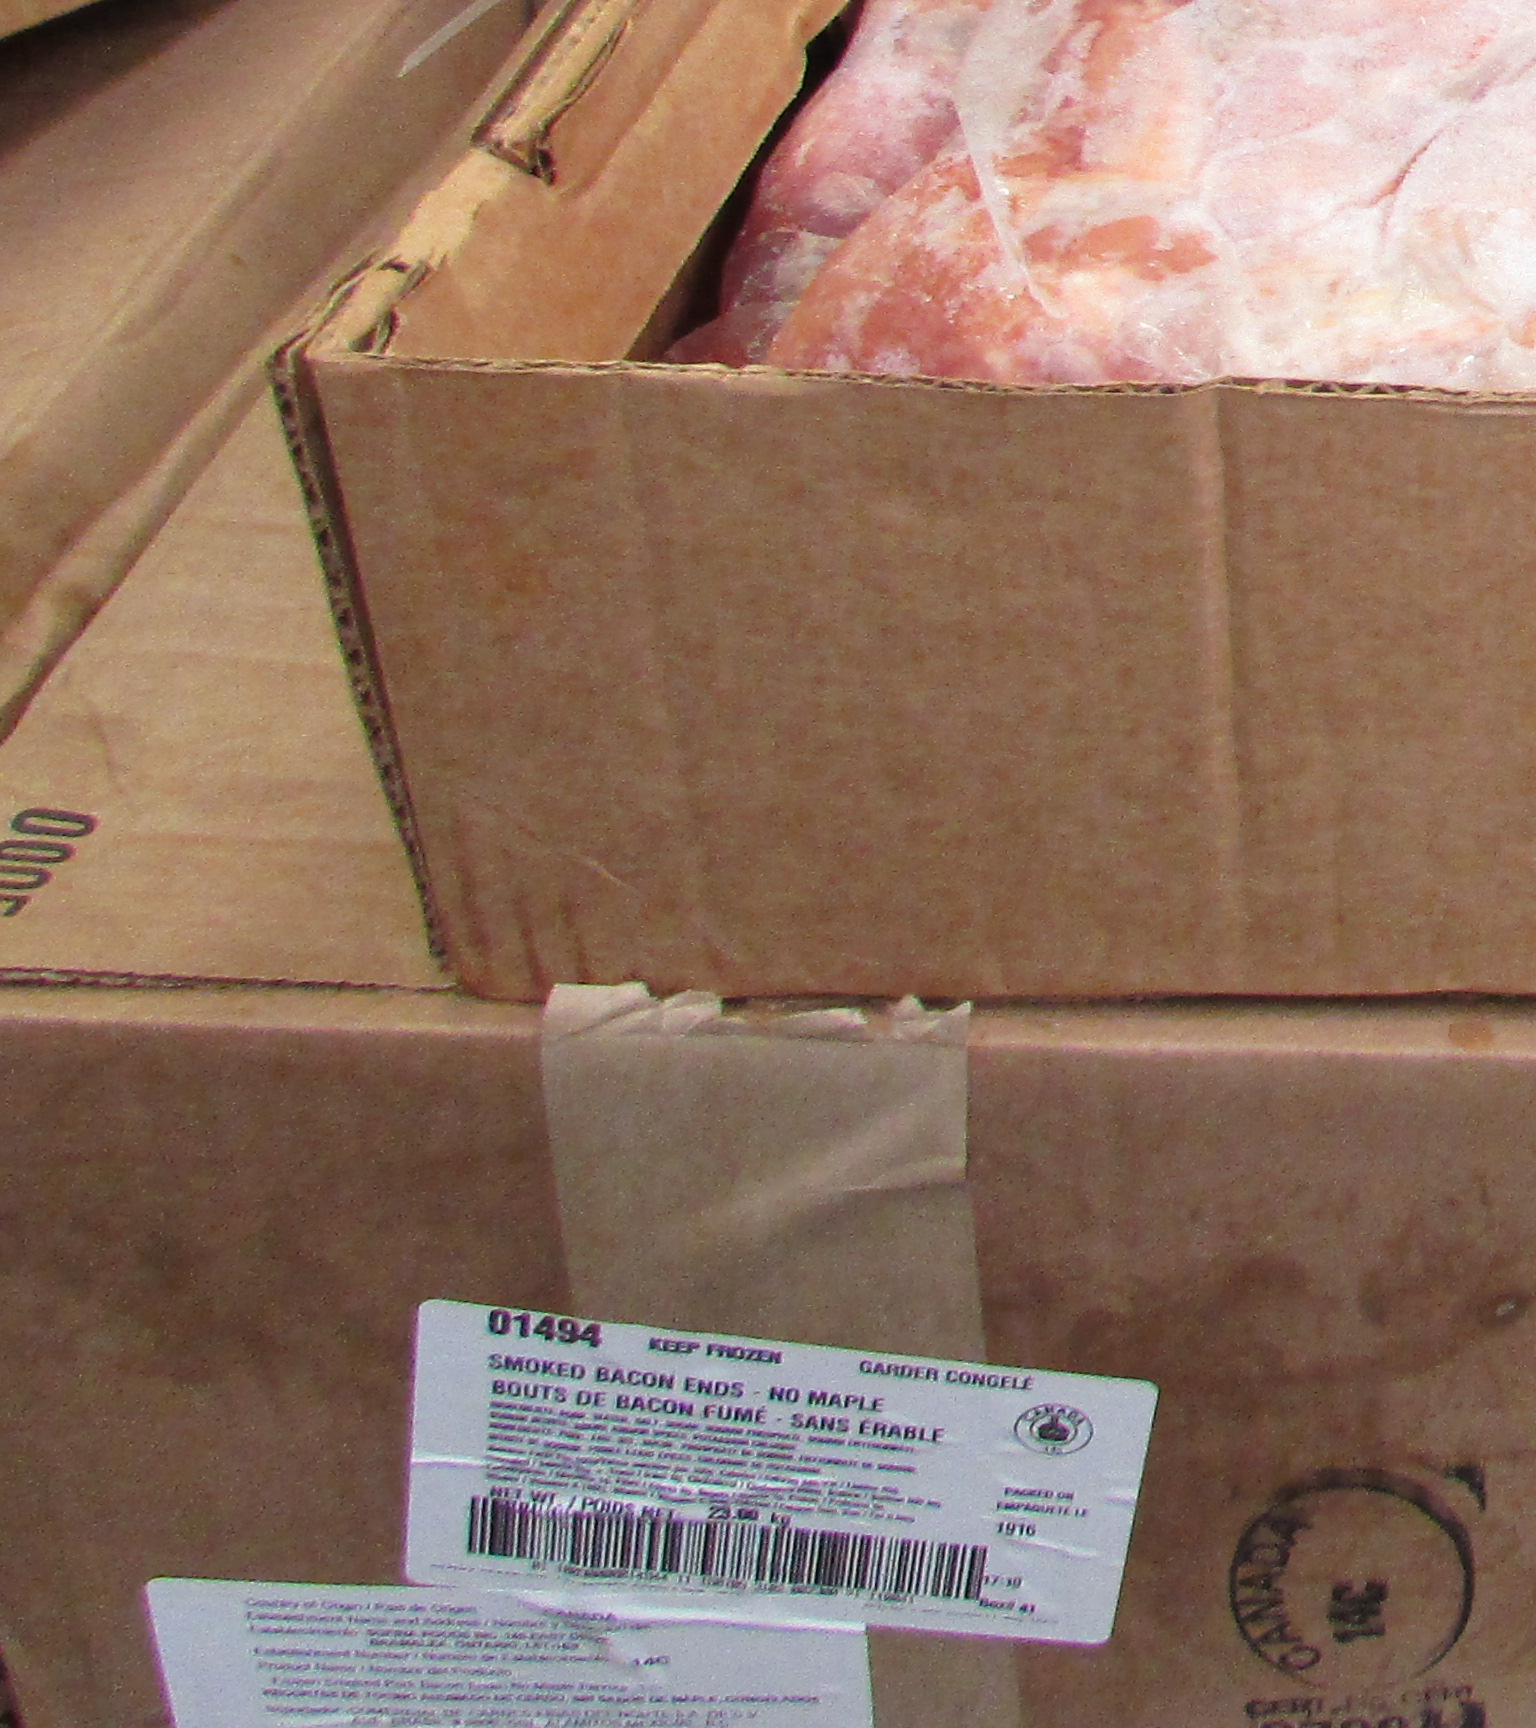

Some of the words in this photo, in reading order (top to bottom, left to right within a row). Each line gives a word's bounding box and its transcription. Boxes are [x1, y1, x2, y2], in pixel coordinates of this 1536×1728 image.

[488, 1353, 586, 1380] SMOKED
[596, 1365, 675, 1390] BACON
[683, 1376, 745, 1398] ENDS
[769, 1386, 800, 1404] NO
[808, 1389, 885, 1413] MAPLE
[489, 1309, 602, 1348] 01494
[649, 1337, 701, 1354] KEEP
[705, 1342, 783, 1364] FROZEN
[859, 1359, 939, 1383] GARDER
[945, 1368, 1034, 1391] CONGELÉ
[491, 1378, 568, 1403] BOUTS
[576, 1390, 607, 1407] DE
[615, 1393, 695, 1417] BACON
[703, 1402, 767, 1424] FUMÉ
[791, 1412, 850, 1433] SANS
[859, 1416, 946, 1444] ÉRABLE
[1233, 1510, 1323, 1671] CANADA
